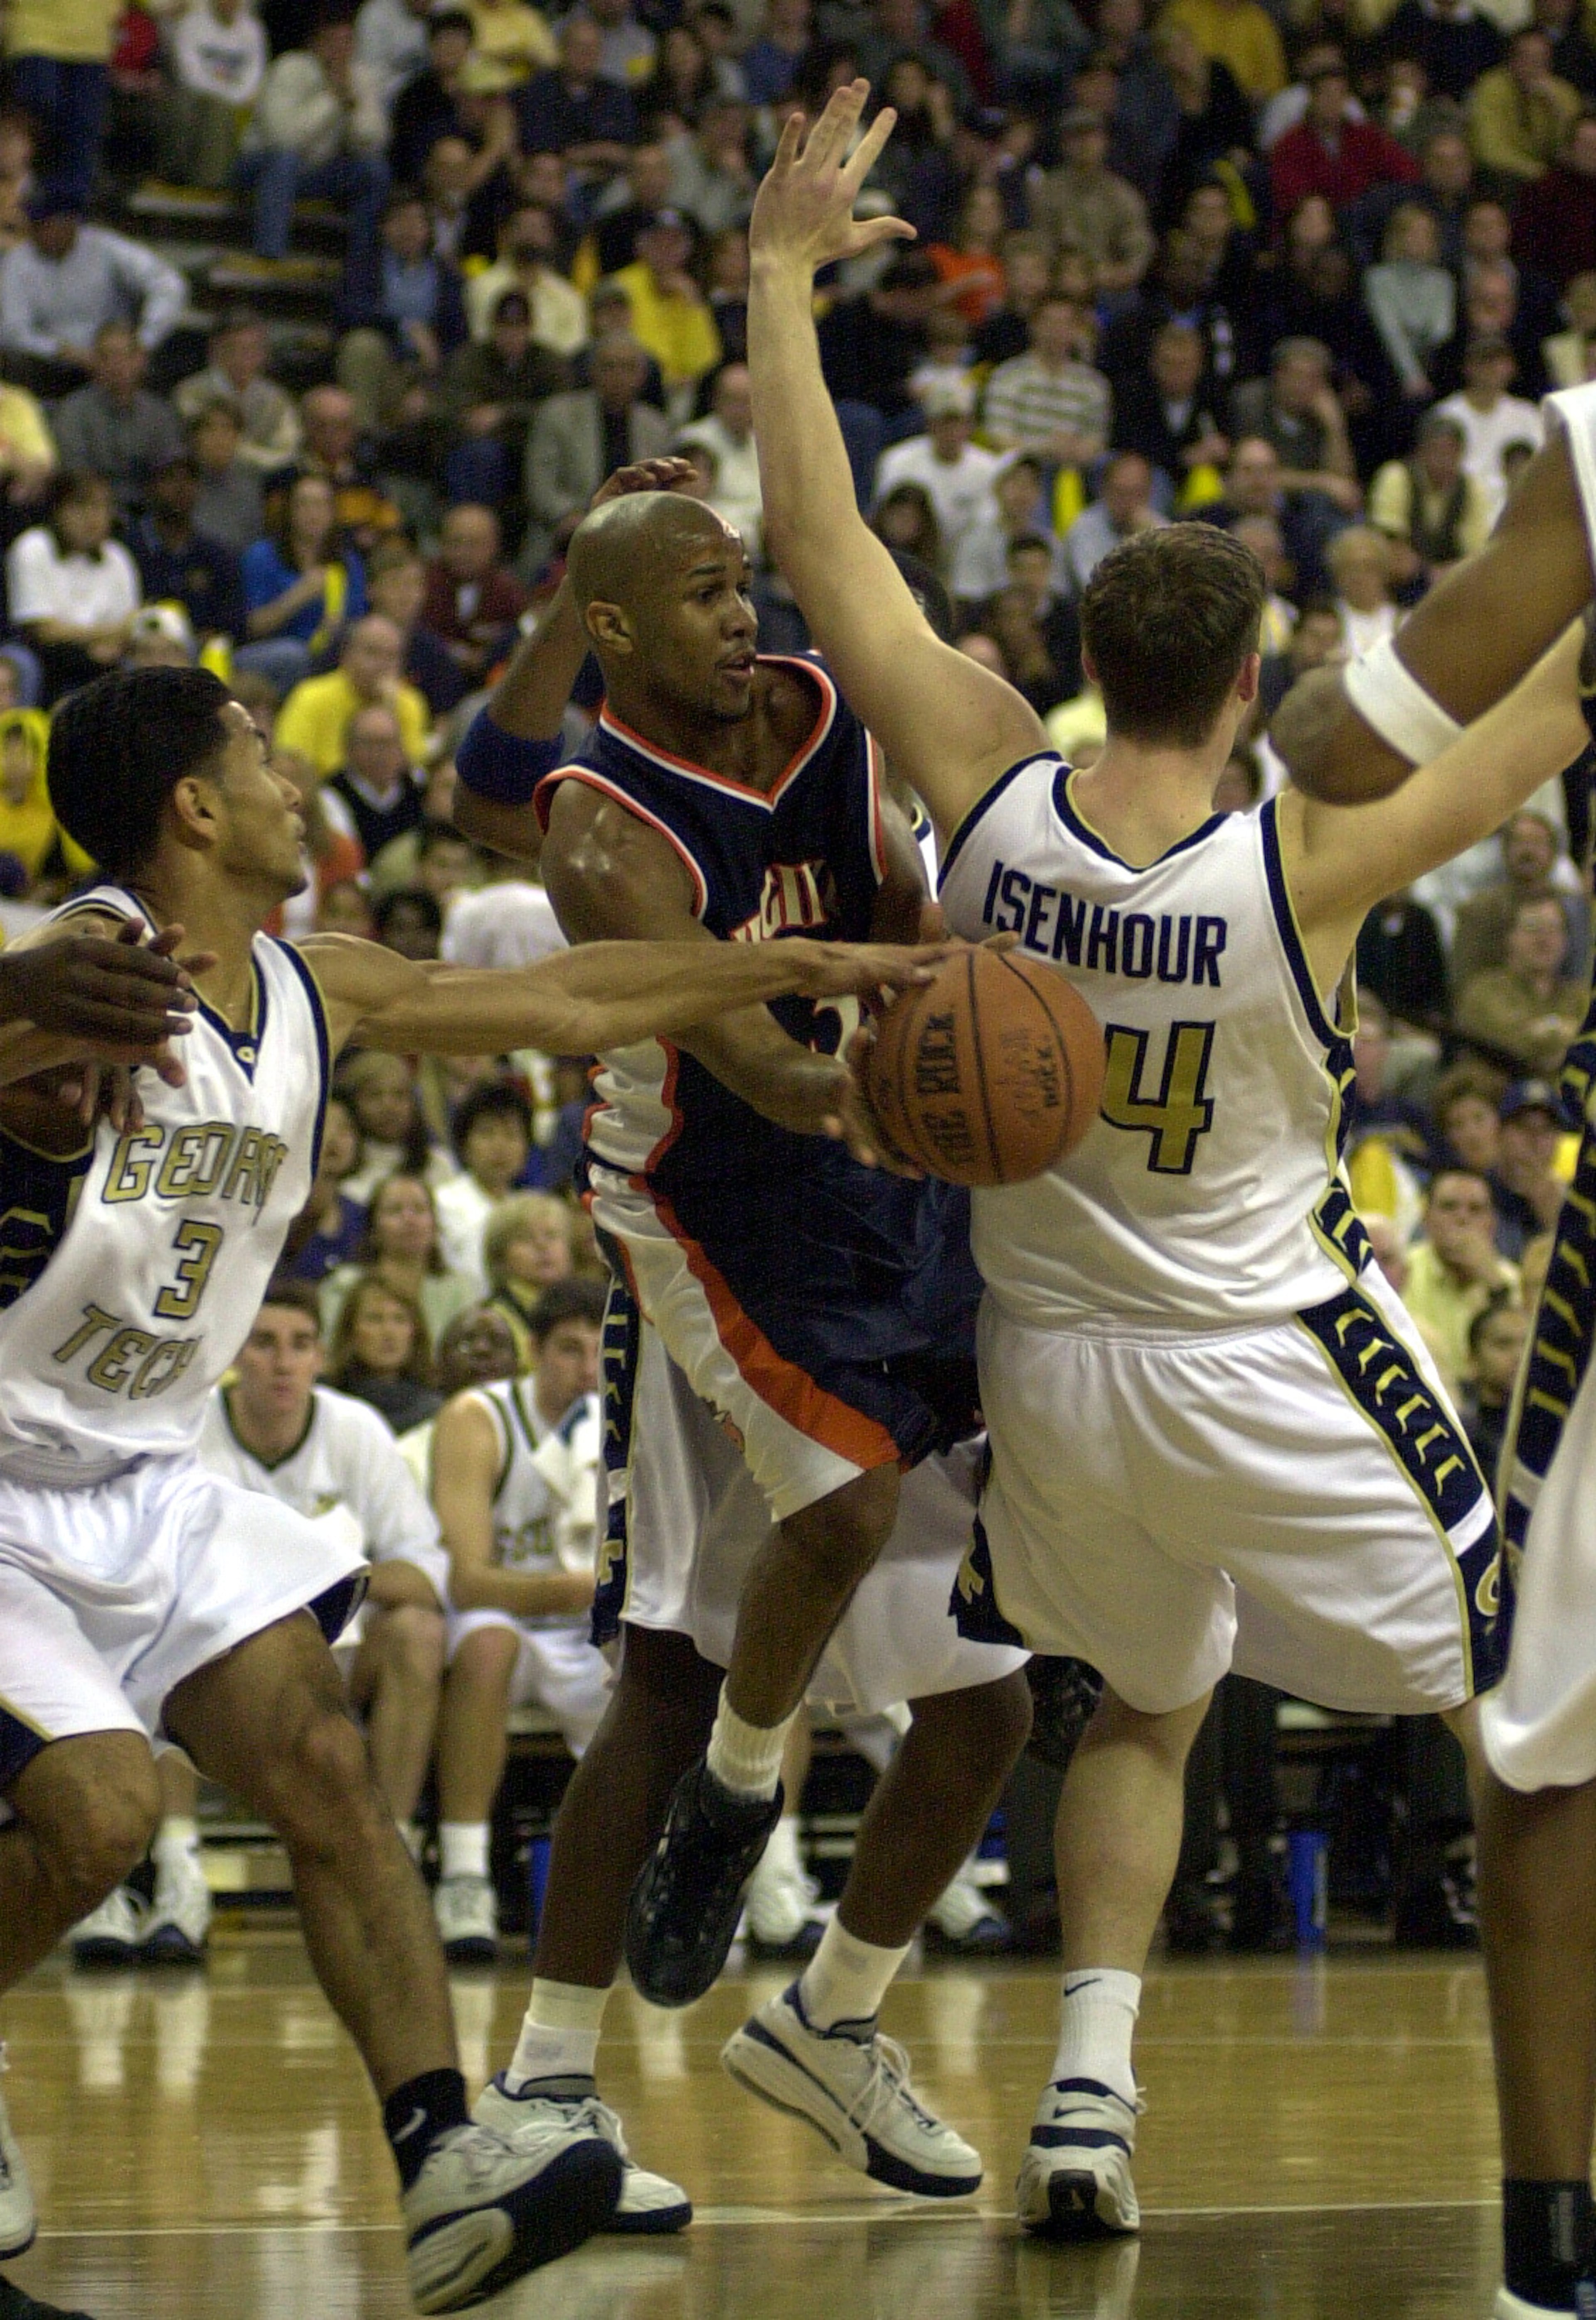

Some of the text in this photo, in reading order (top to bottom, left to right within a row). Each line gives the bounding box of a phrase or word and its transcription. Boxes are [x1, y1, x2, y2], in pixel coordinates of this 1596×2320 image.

[982, 860, 1228, 987] ISENHOUR
[1101, 1020, 1216, 1175] 4
[152, 1219, 224, 1320] 3
